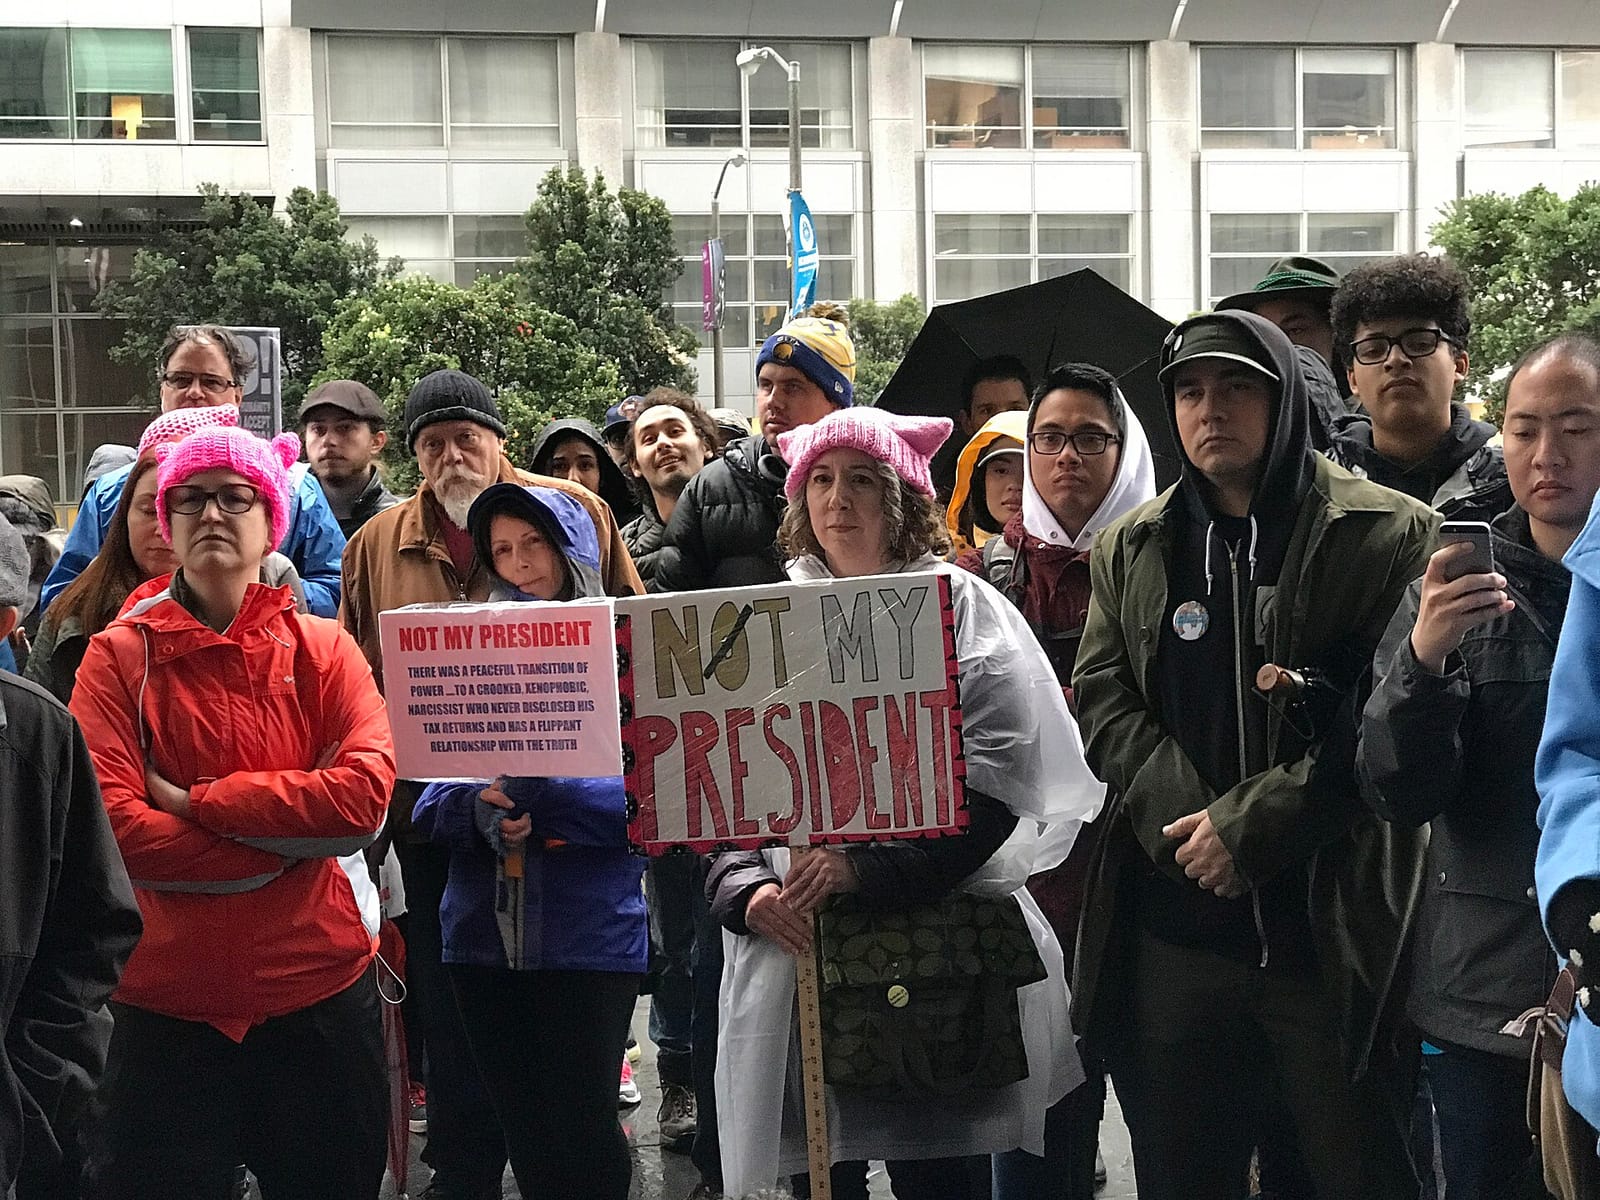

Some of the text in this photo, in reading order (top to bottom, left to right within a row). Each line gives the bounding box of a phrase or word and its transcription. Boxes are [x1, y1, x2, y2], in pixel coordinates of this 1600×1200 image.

[244, 415, 271, 429] ACCEPT
[399, 621, 592, 652] NOT MY PRESIDENT
[652, 586, 929, 698] NOT MY
[408, 662, 588, 678] THERE WAS A PEACEFUL TRANSITION OF
[410, 685, 444, 697] POWER
[468, 684, 475, 695] A
[477, 682, 524, 696] CROOKED,
[525, 681, 589, 694] XENOPHOBIC,
[408, 700, 595, 715] NARCISSIST WHO NEVER DISCLOSED HIS
[423, 719, 582, 734] TAX RETURNS AND HAS A FLIPPANT
[430, 739, 577, 753] RELATIONSHIP WITH THE TRUTH
[635, 690, 957, 841] PRESIDENT
